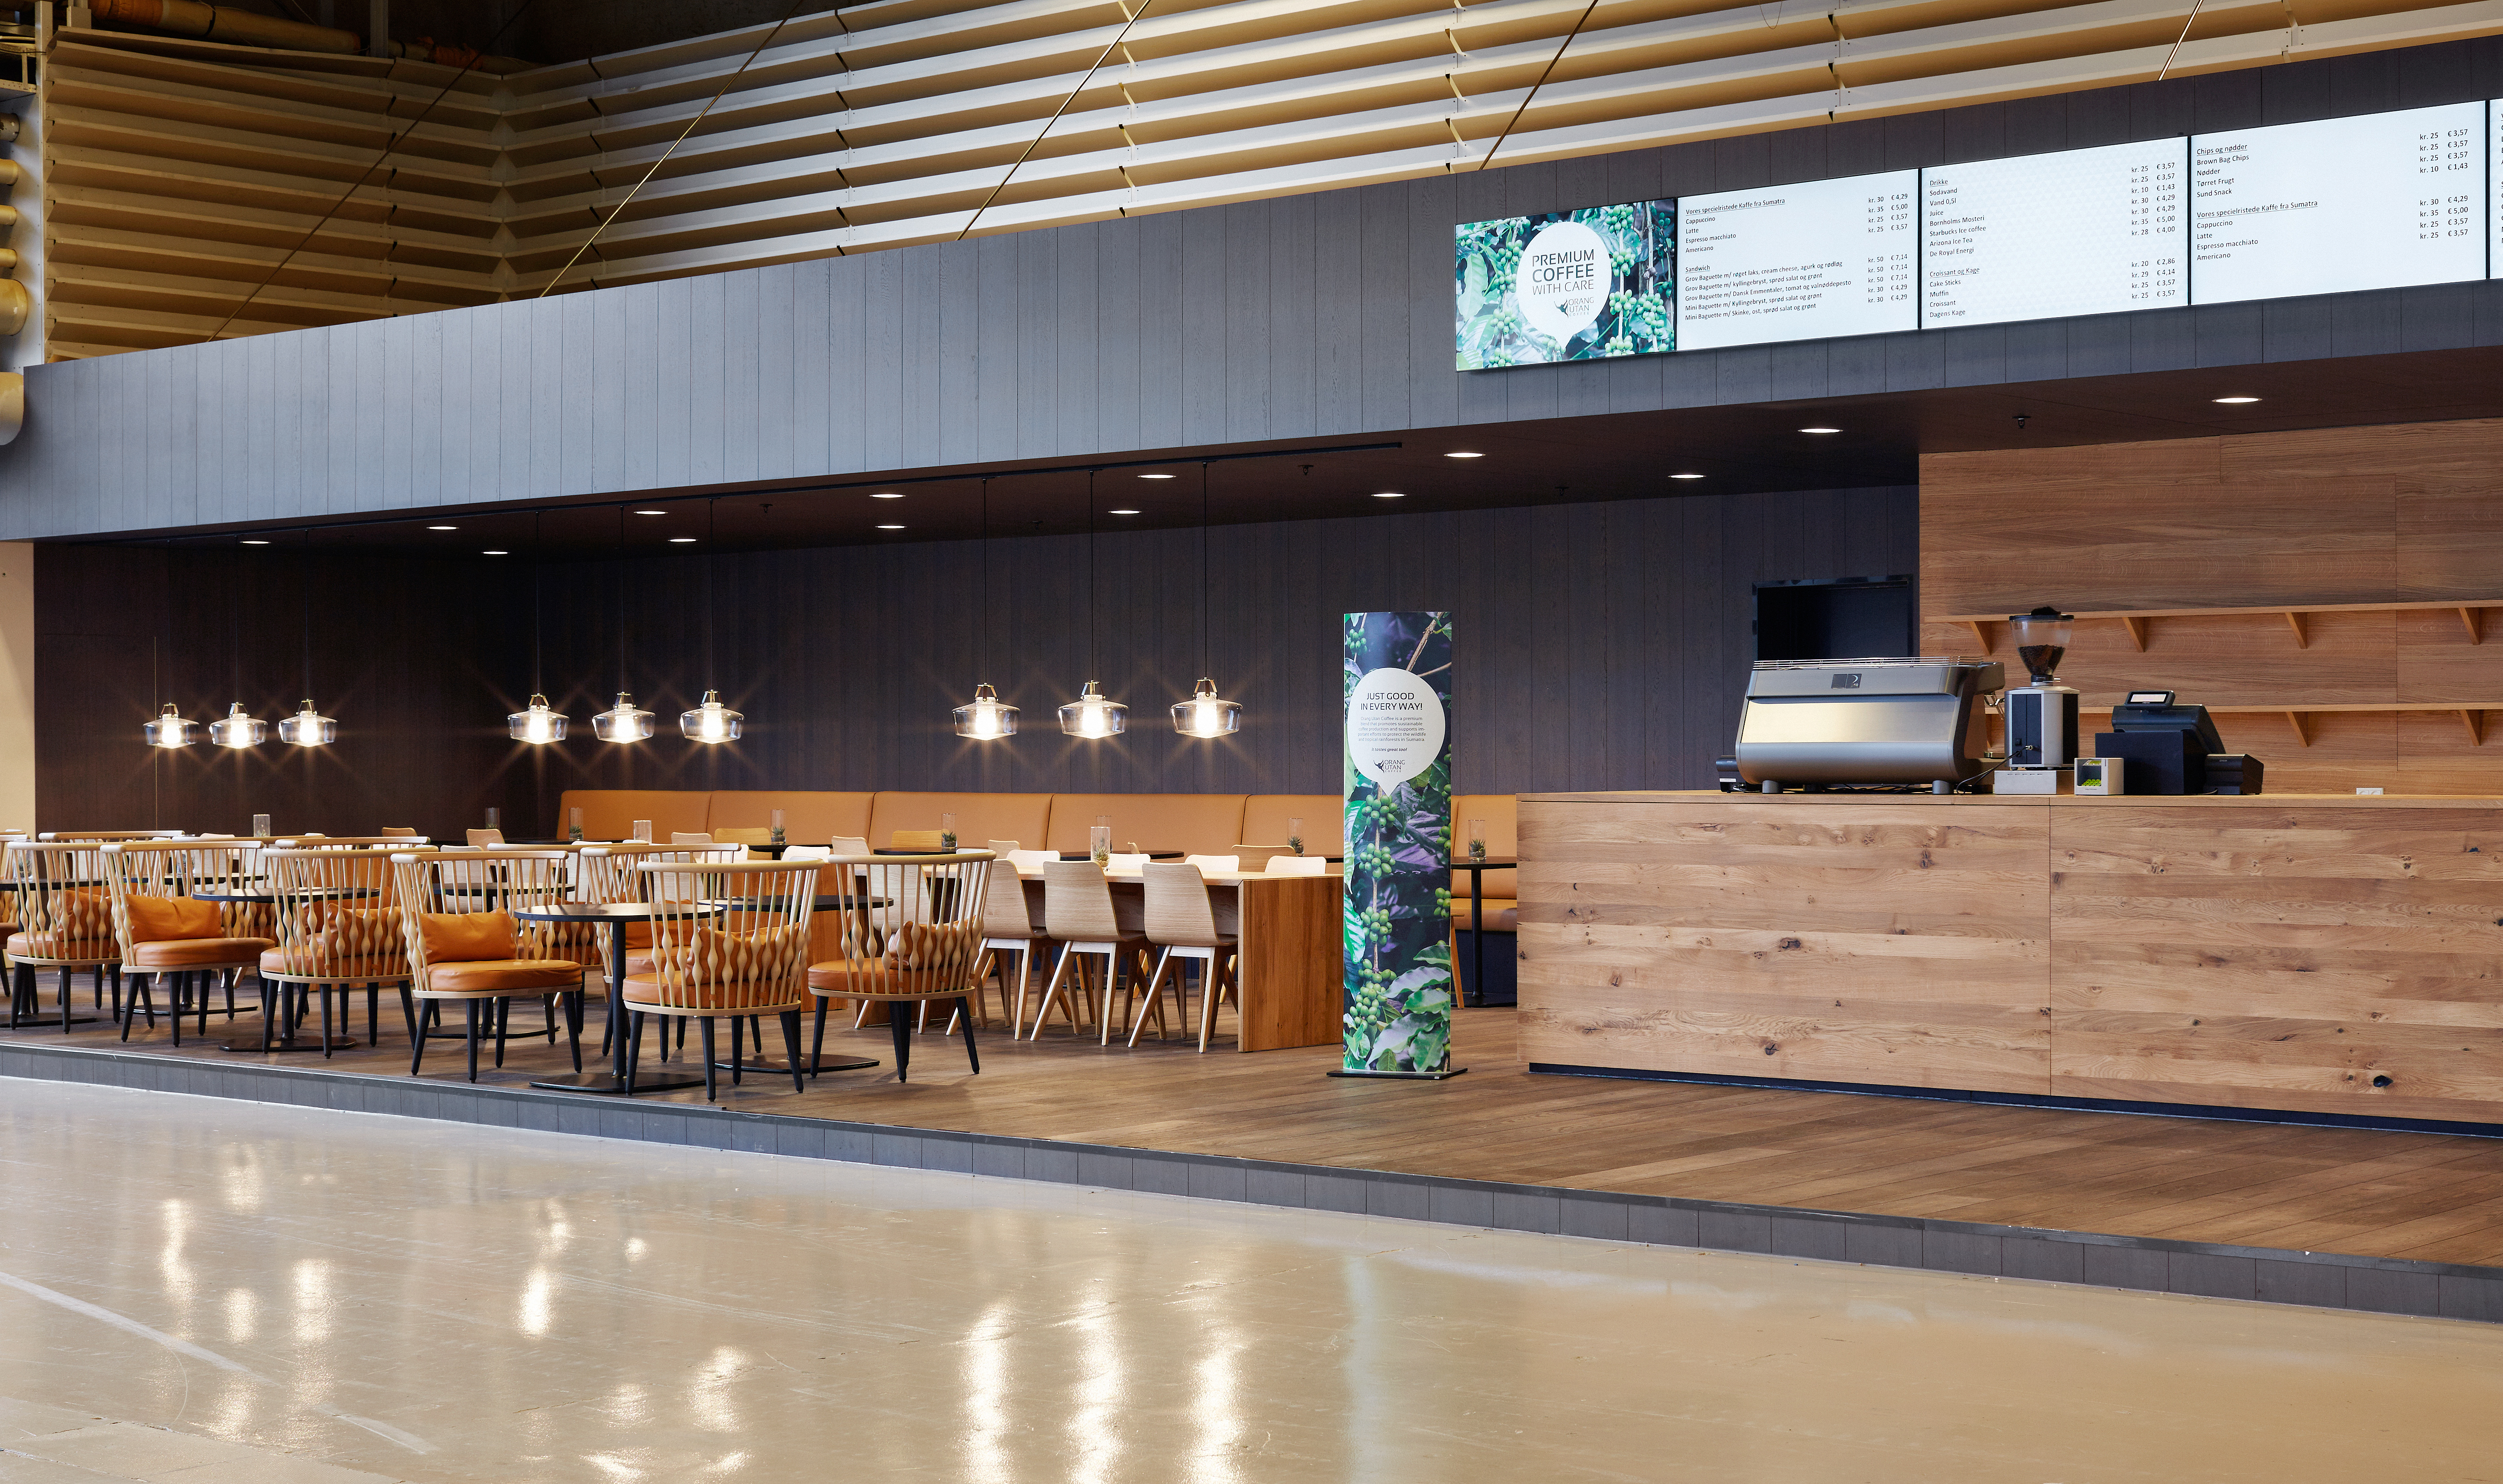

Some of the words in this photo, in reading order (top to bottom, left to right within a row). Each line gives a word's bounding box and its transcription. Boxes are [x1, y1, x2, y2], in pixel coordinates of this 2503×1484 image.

[1930, 187, 1957, 196] Sodavand
[2197, 220, 2232, 229] Cappuccino
[1533, 249, 1594, 266] PREMIUM
[1533, 263, 1593, 282] COFFEE
[1533, 283, 1560, 295] WITH
[1565, 279, 1593, 291] CARE
[1733, 279, 1767, 287] kyllingebryst,
[1569, 297, 1594, 305] ORANG
[1732, 299, 1767, 307] Kyllingebryst,
